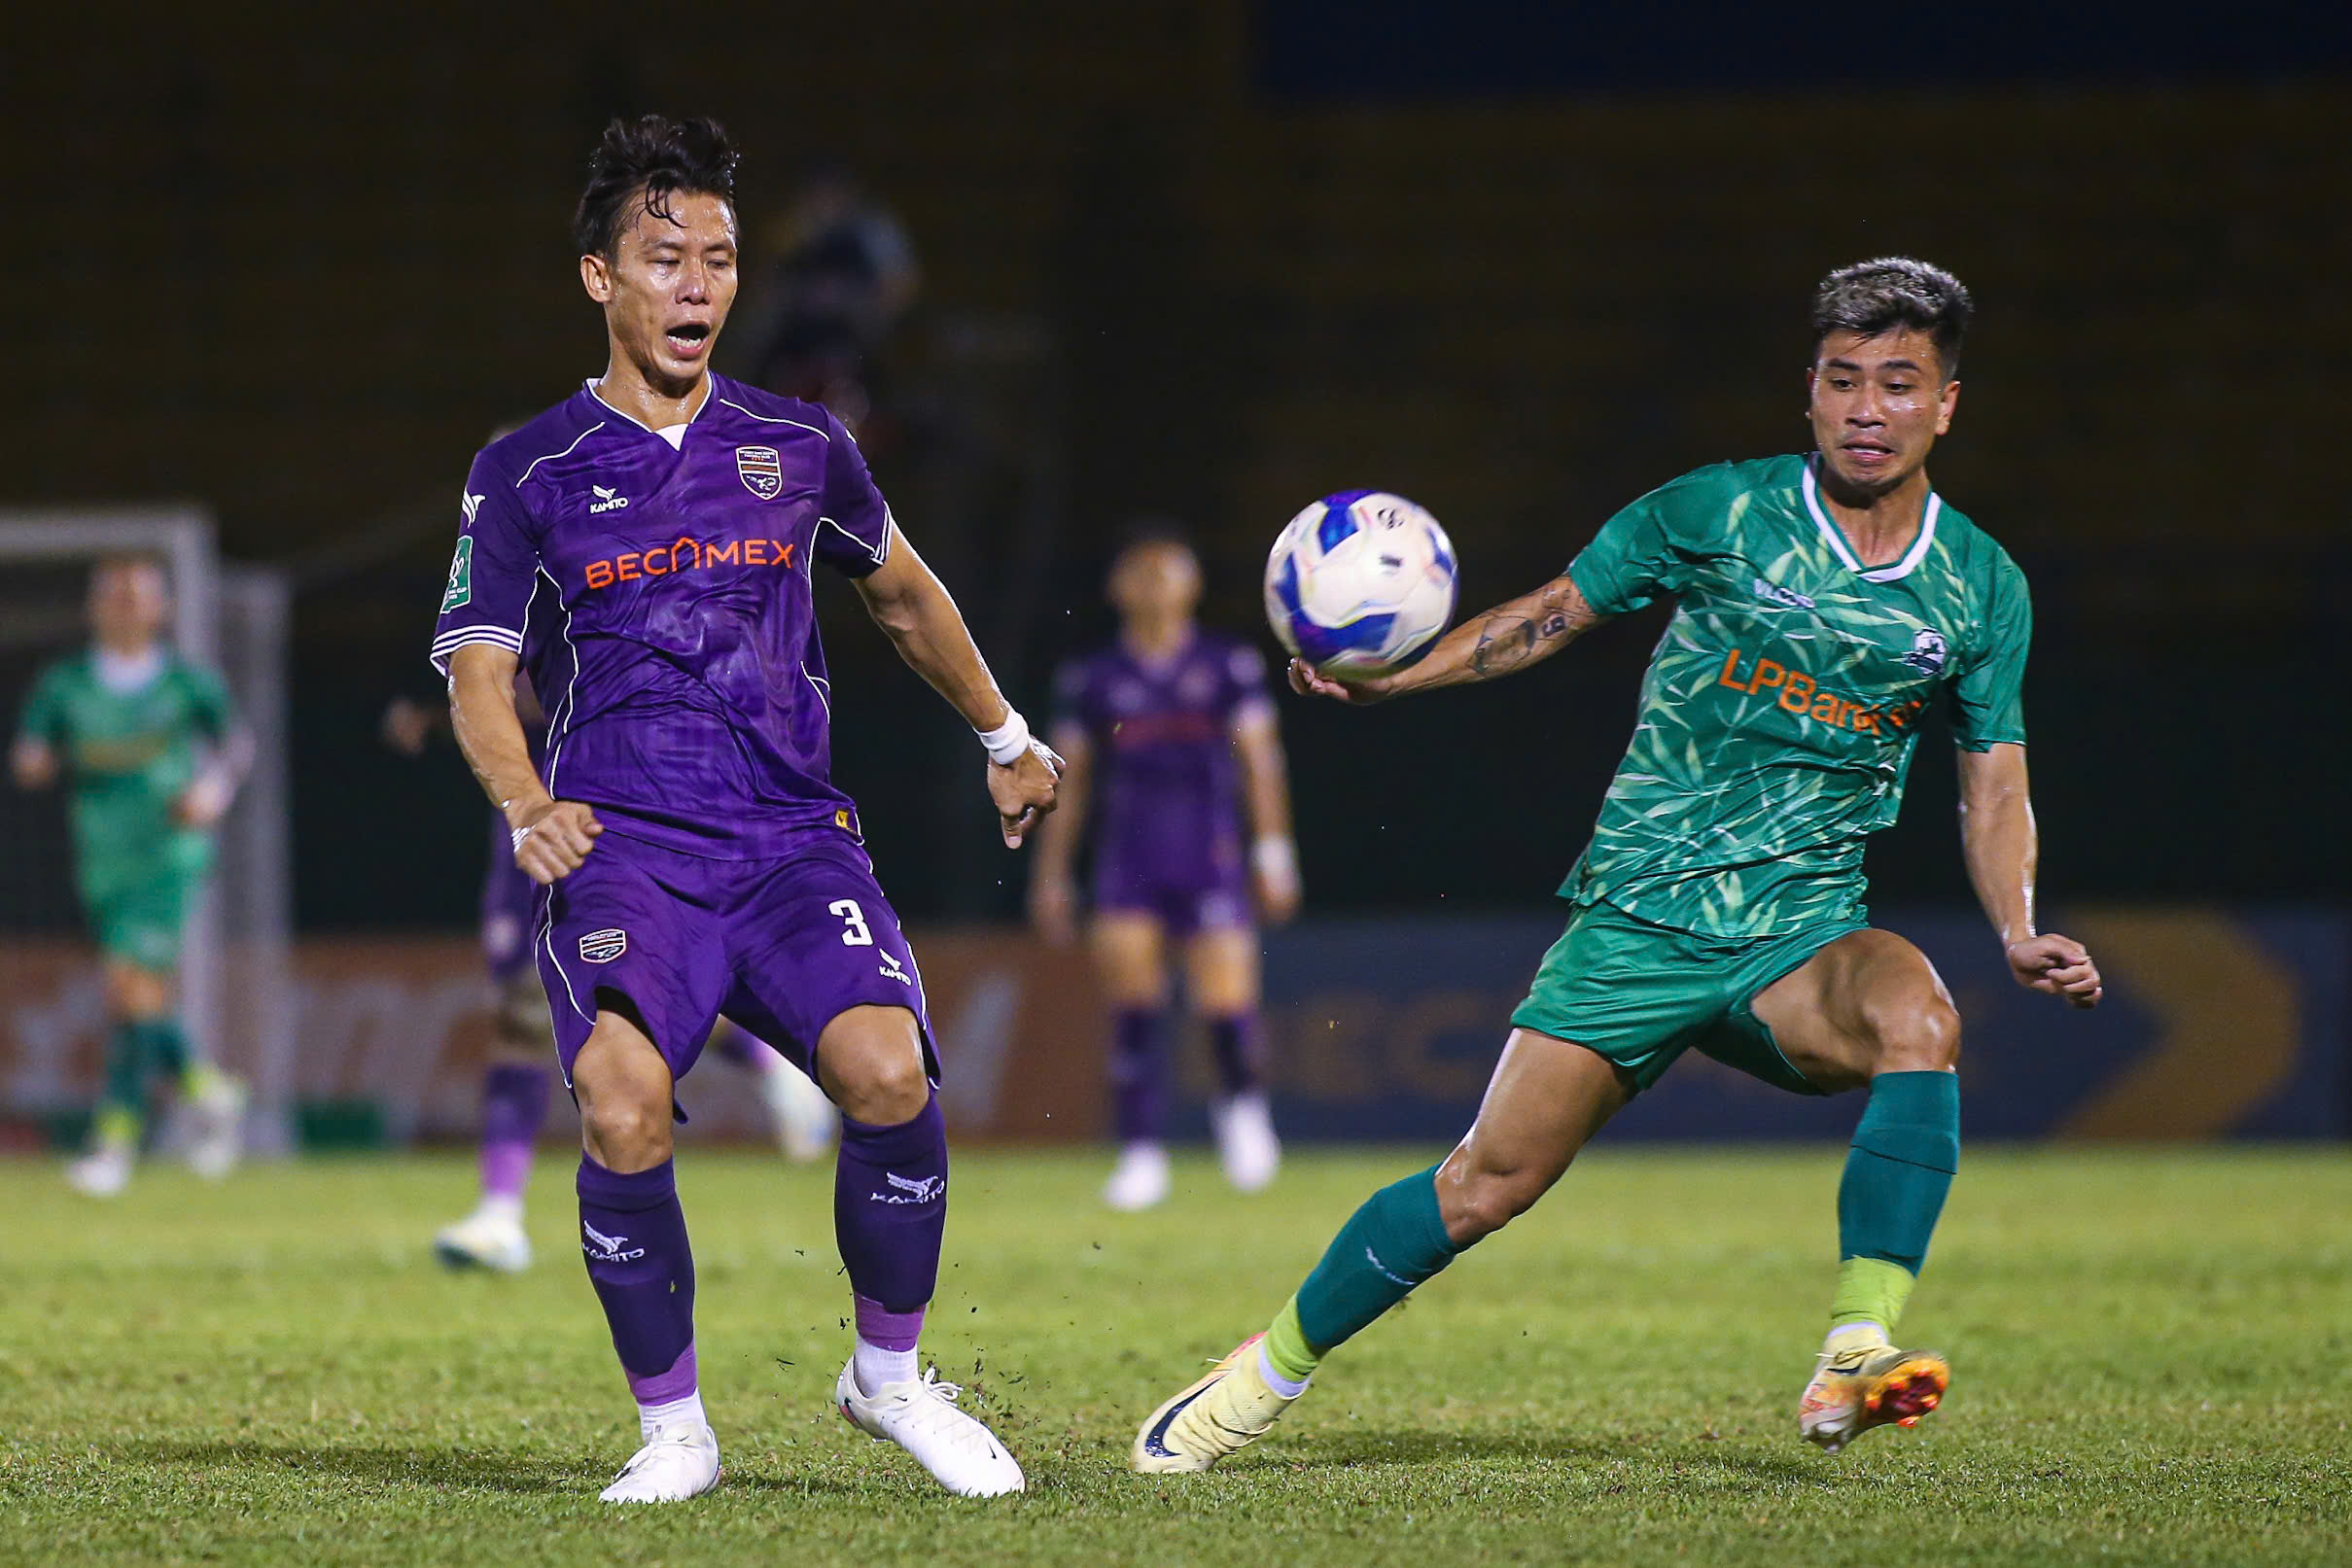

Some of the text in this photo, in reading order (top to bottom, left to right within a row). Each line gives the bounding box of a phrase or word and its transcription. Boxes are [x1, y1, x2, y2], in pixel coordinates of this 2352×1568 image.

[589, 497, 629, 513] KAMITO
[584, 537, 794, 590] BECAMEX
[827, 899, 874, 946] 3
[878, 965, 912, 987] KAMITO
